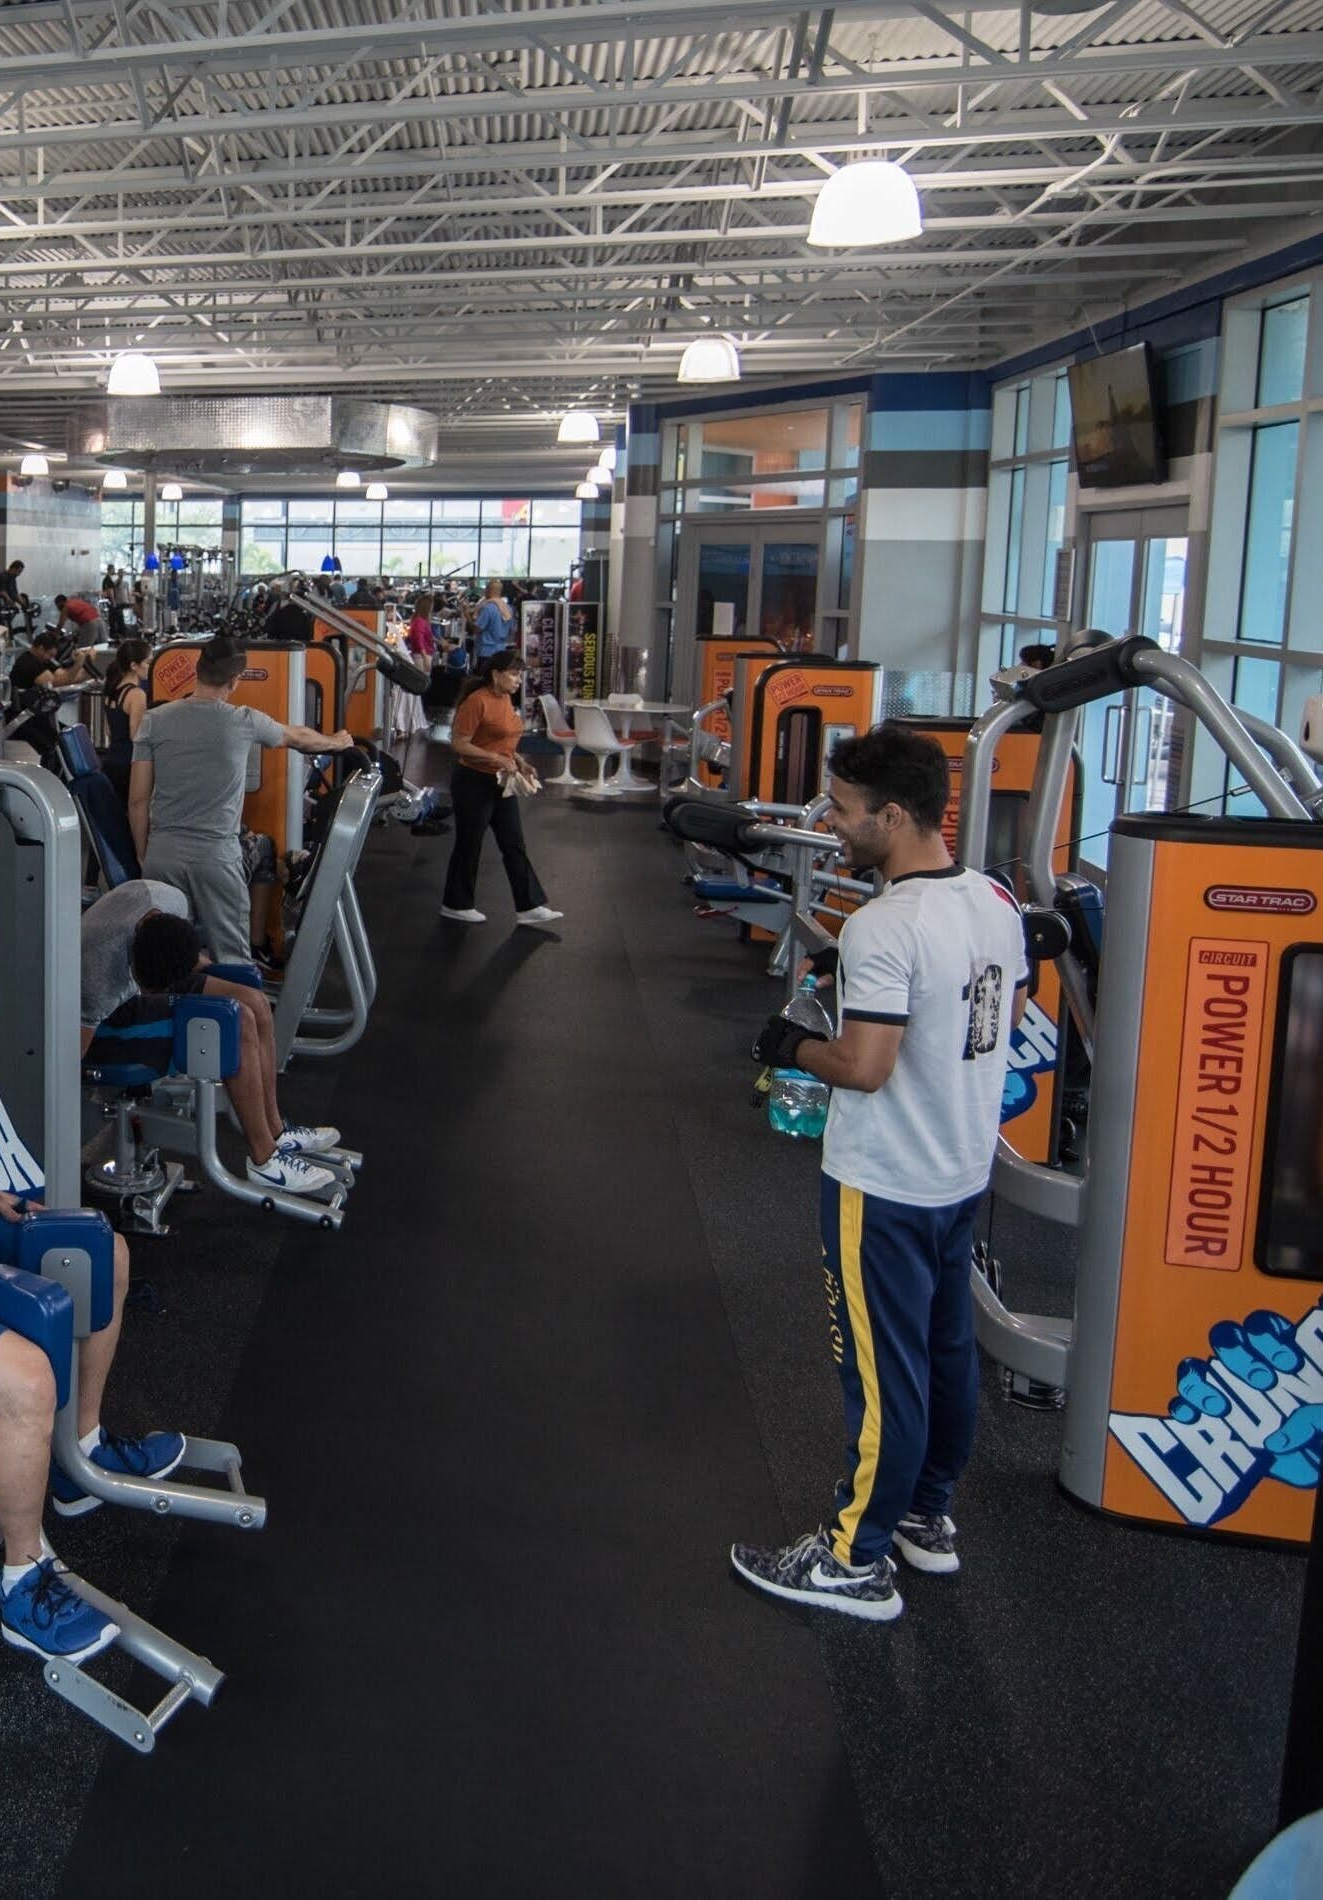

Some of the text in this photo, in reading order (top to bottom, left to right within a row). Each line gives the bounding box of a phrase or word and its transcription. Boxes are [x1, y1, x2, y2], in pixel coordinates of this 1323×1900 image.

[540, 617, 554, 695] CLASSIC TRAIN
[583, 632, 597, 677] SERIOUS
[1214, 892, 1306, 908] STAR TRAC
[1198, 950, 1257, 968] CIRCUIT
[1184, 973, 1251, 1256] POWER 1/2 HOUR
[1108, 1309, 1323, 1525] CRUN
